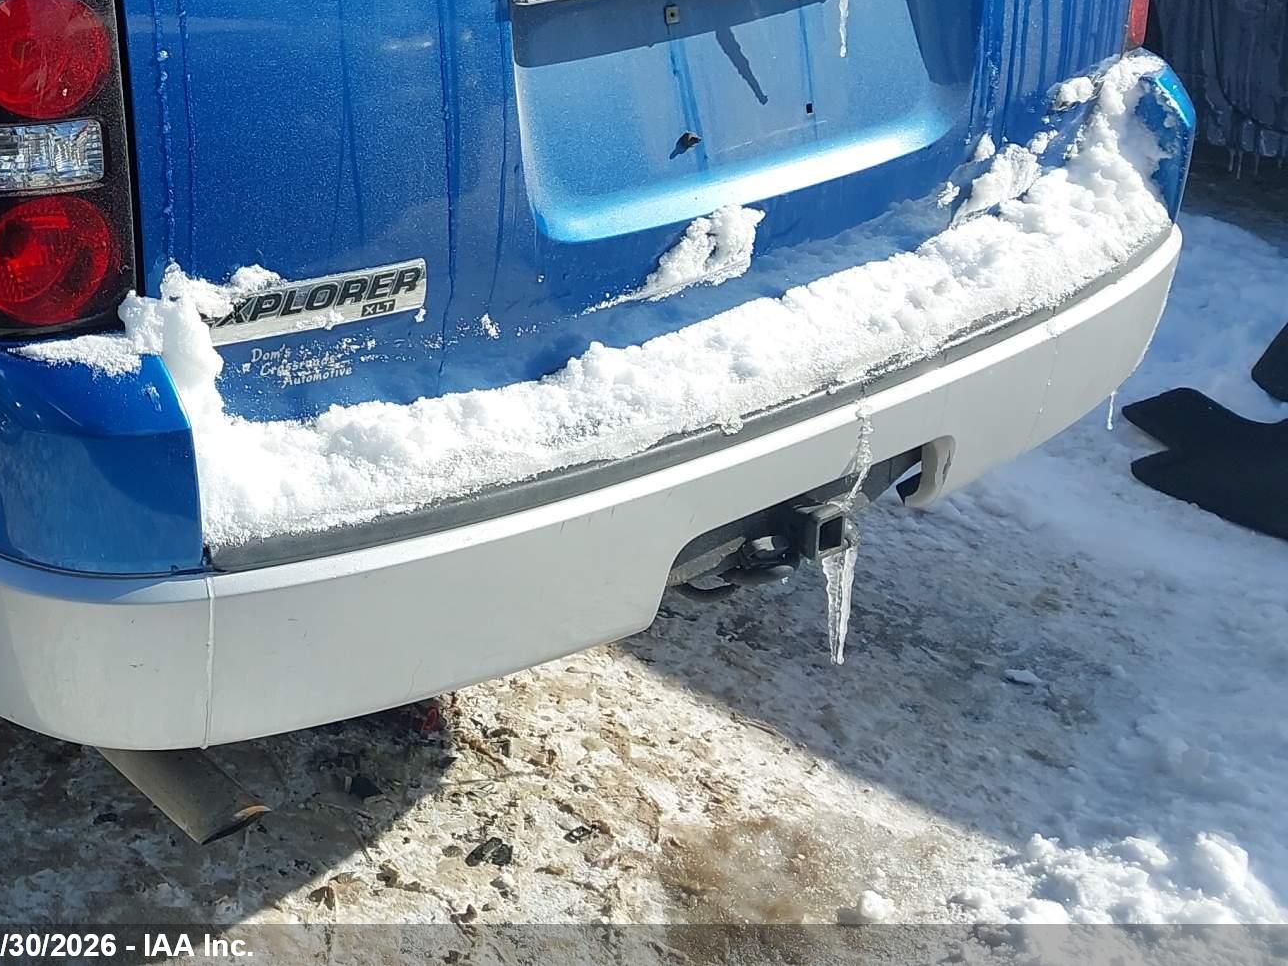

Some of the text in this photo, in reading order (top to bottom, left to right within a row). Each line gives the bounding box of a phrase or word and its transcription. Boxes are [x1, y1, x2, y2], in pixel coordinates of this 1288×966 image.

[198, 267, 423, 328] XPLORER
[363, 300, 394, 316] XLT
[251, 344, 291, 363] Dom's
[280, 366, 353, 388] Automotive
